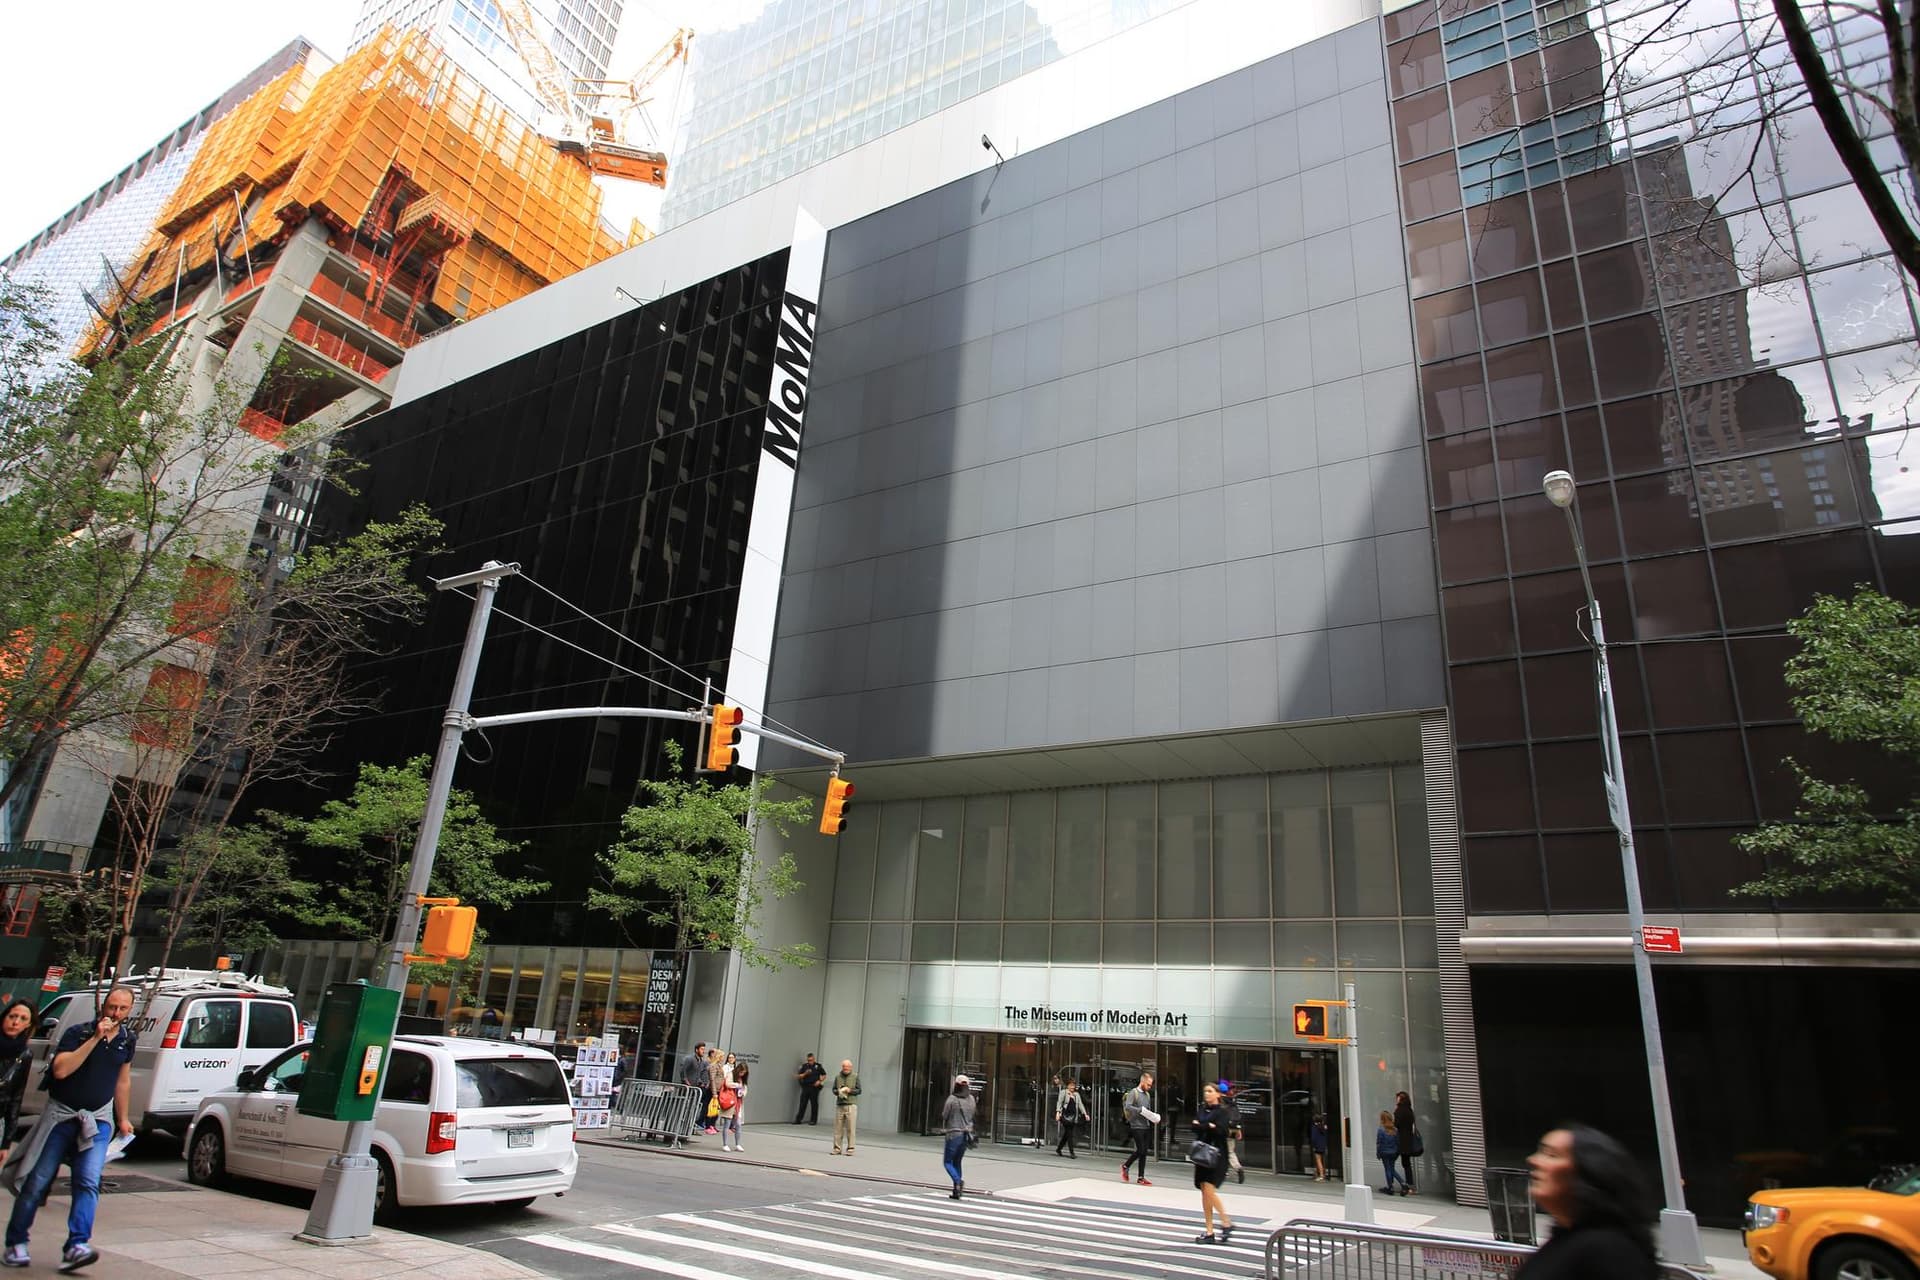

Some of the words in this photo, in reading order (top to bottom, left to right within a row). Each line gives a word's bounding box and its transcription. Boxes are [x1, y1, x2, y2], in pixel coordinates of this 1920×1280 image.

[761, 291, 818, 470] MoMA
[650, 981, 669, 991] AND
[1005, 1006, 1028, 1019] The
[1031, 1007, 1087, 1022] Museum
[1090, 1010, 1103, 1023] of
[1107, 1010, 1160, 1025] Modern
[1164, 1012, 1188, 1026] Art
[184, 1057, 227, 1069] verizon
[1423, 1247, 1478, 1264] NATIONAL
